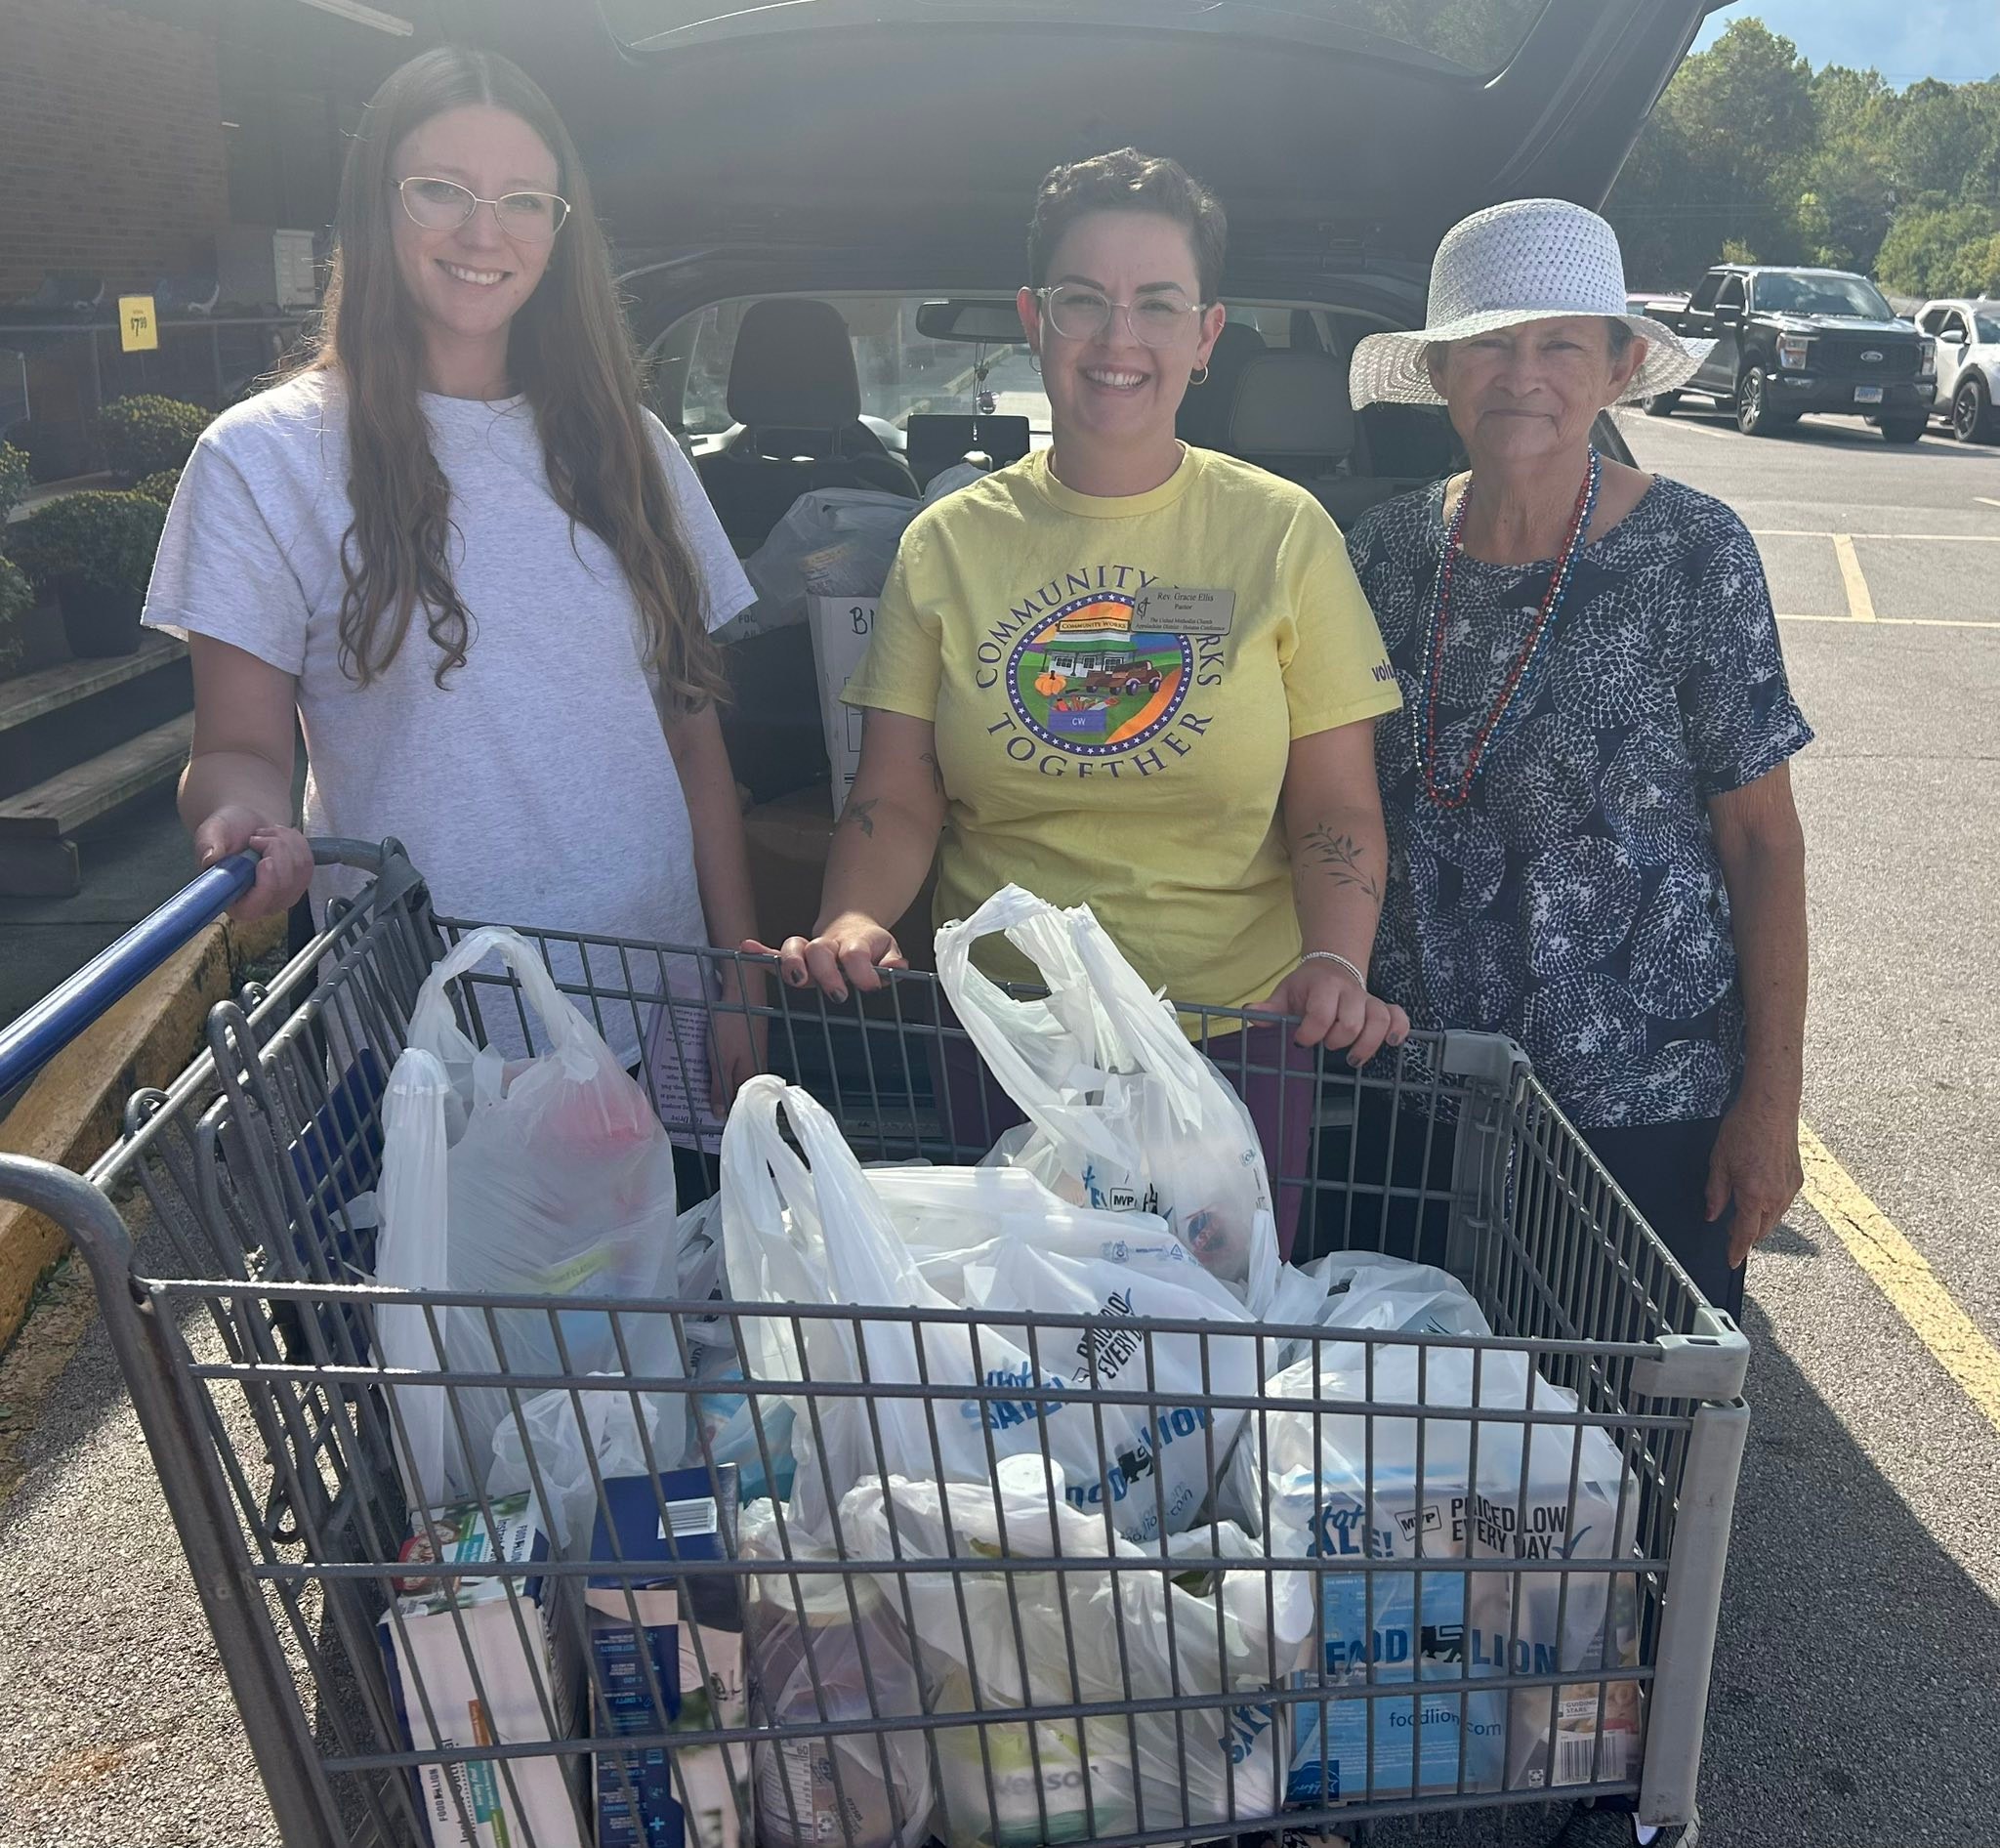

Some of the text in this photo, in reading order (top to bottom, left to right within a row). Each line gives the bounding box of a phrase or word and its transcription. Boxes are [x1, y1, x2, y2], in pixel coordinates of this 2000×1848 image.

[1174, 592, 1196, 602] Gracie
[1197, 593, 1214, 602] Ellis
[976, 565, 1159, 690] COMMUNITY
[1103, 620, 1126, 629] WORKS
[1071, 717, 1087, 727] CW
[1113, 1195, 1134, 1205] MVP
